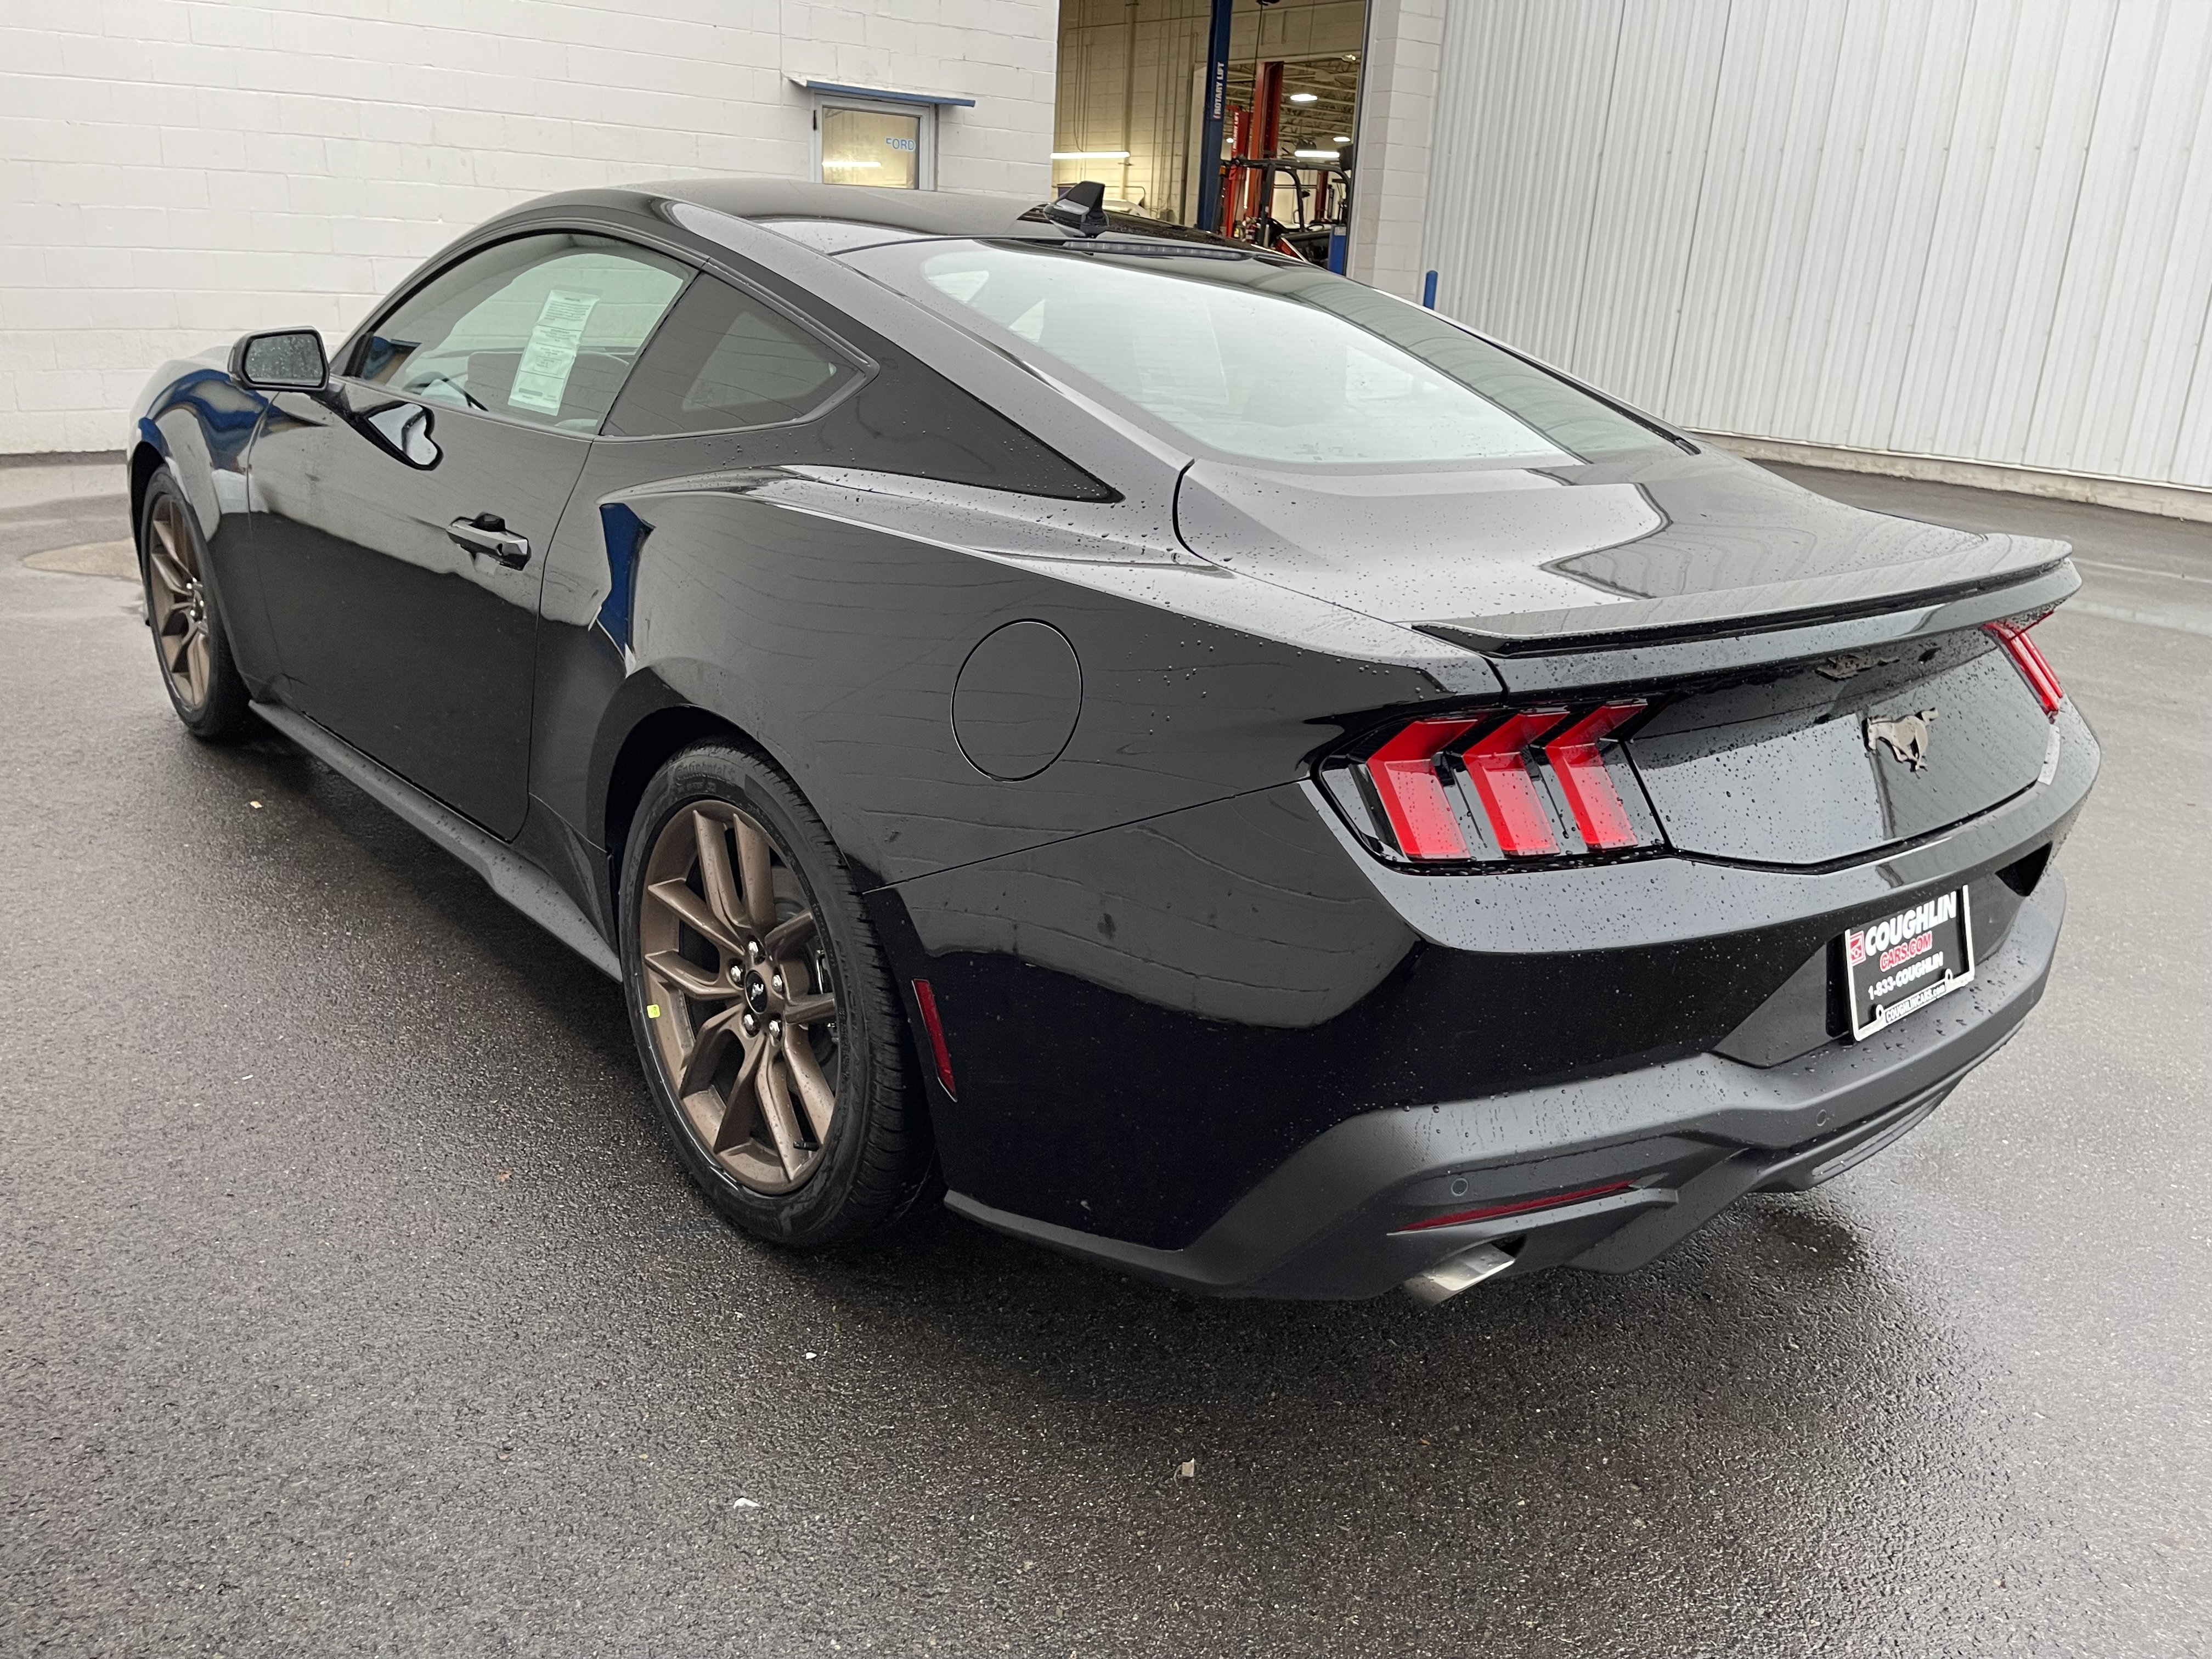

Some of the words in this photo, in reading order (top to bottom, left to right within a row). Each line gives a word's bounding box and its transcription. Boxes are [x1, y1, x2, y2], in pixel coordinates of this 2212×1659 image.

[1216, 61, 1224, 80] LIFT
[1214, 82, 1223, 115] ROTARY
[1865, 891, 1957, 956] COUGHLIN
[1880, 930, 1932, 972] CARS.COM
[1868, 951, 1944, 1000] 1-833-COUGHLIN
